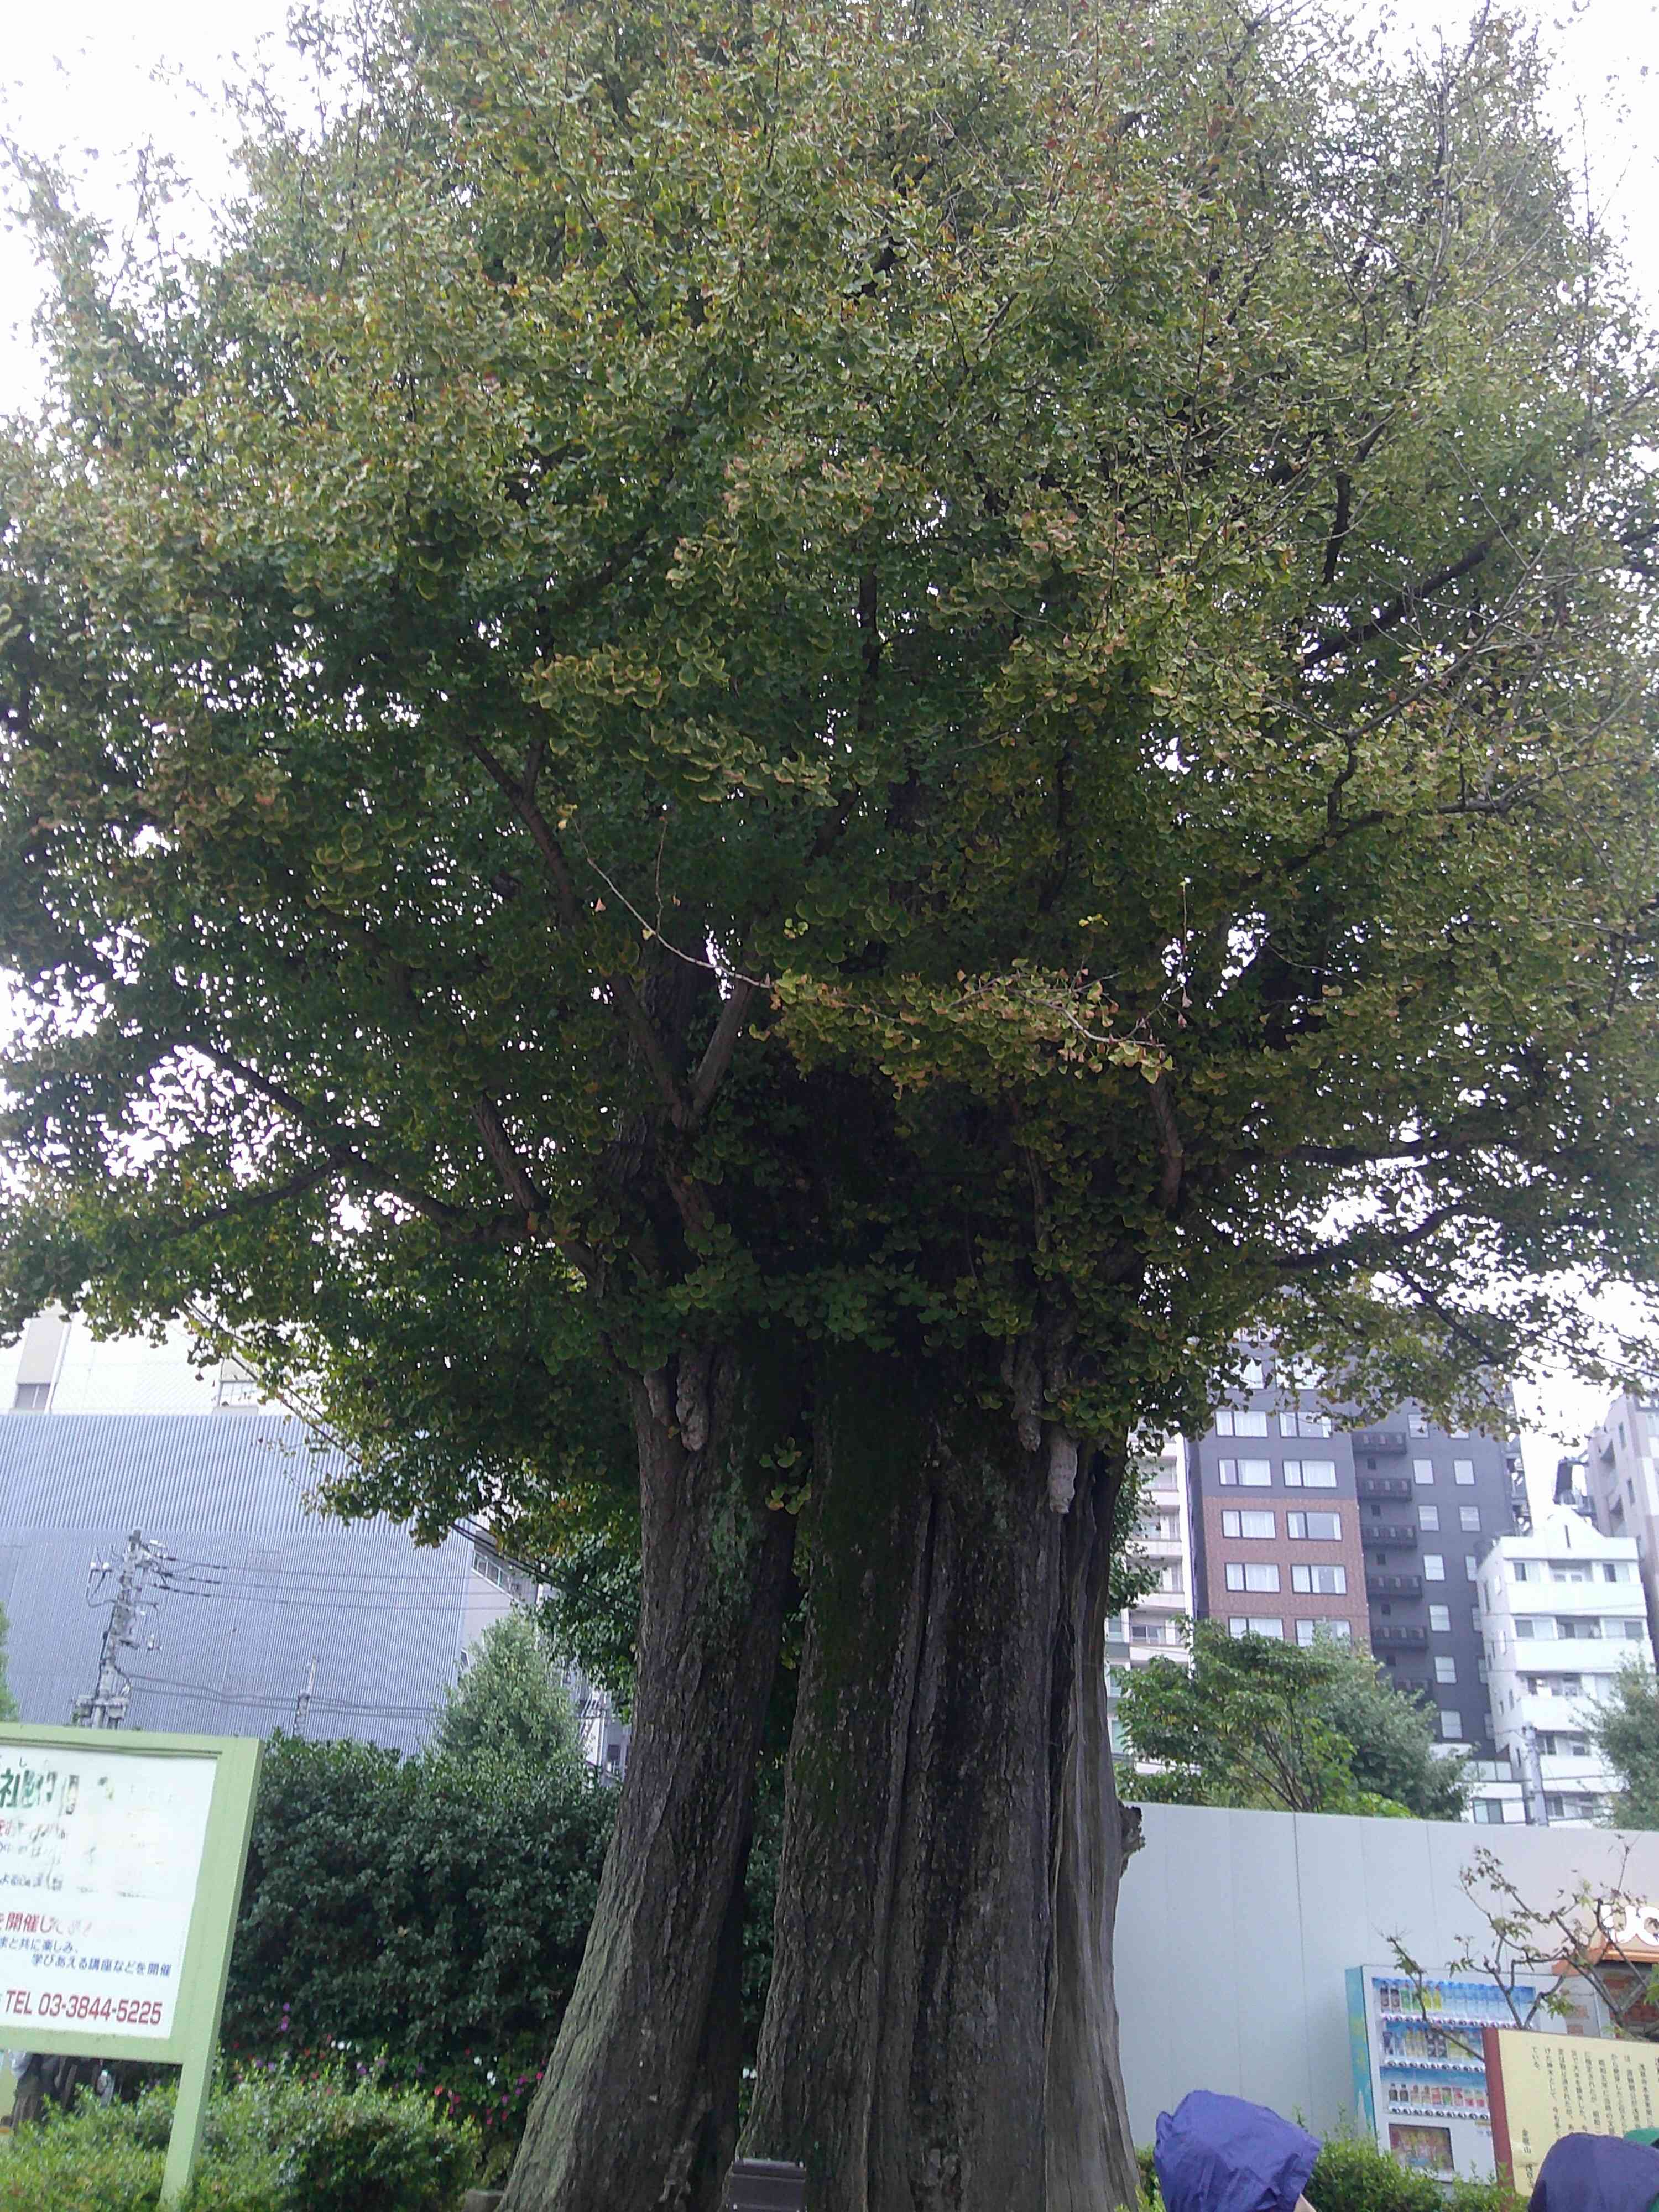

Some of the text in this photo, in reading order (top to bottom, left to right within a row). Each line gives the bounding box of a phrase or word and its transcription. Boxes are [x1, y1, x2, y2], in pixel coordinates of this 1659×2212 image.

[32, 1953, 172, 1978] 学びあえる講座などを開催
[6, 1990, 163, 2025] TEL 03-3844-5225
